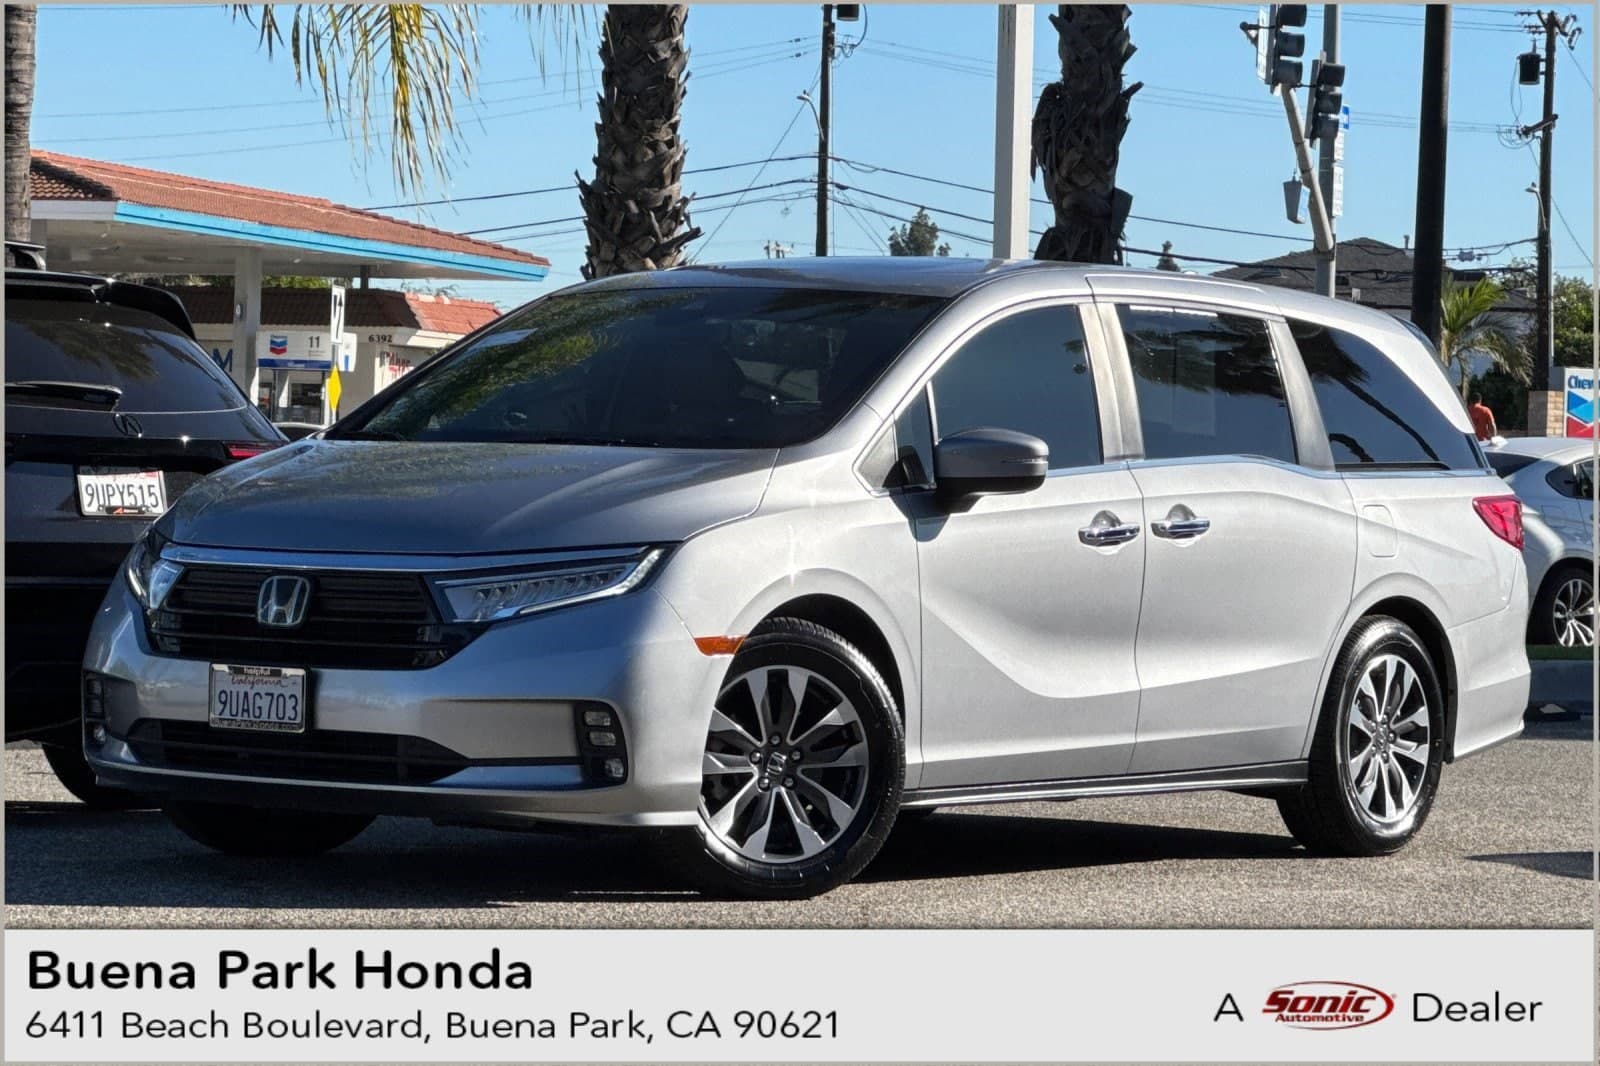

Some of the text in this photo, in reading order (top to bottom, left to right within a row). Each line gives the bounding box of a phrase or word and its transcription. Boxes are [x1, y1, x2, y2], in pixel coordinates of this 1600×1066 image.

[308, 336, 320, 348] 11
[368, 334, 393, 343] 6392
[85, 483, 159, 508] 9UPY515
[218, 690, 298, 721] 9UAG703
